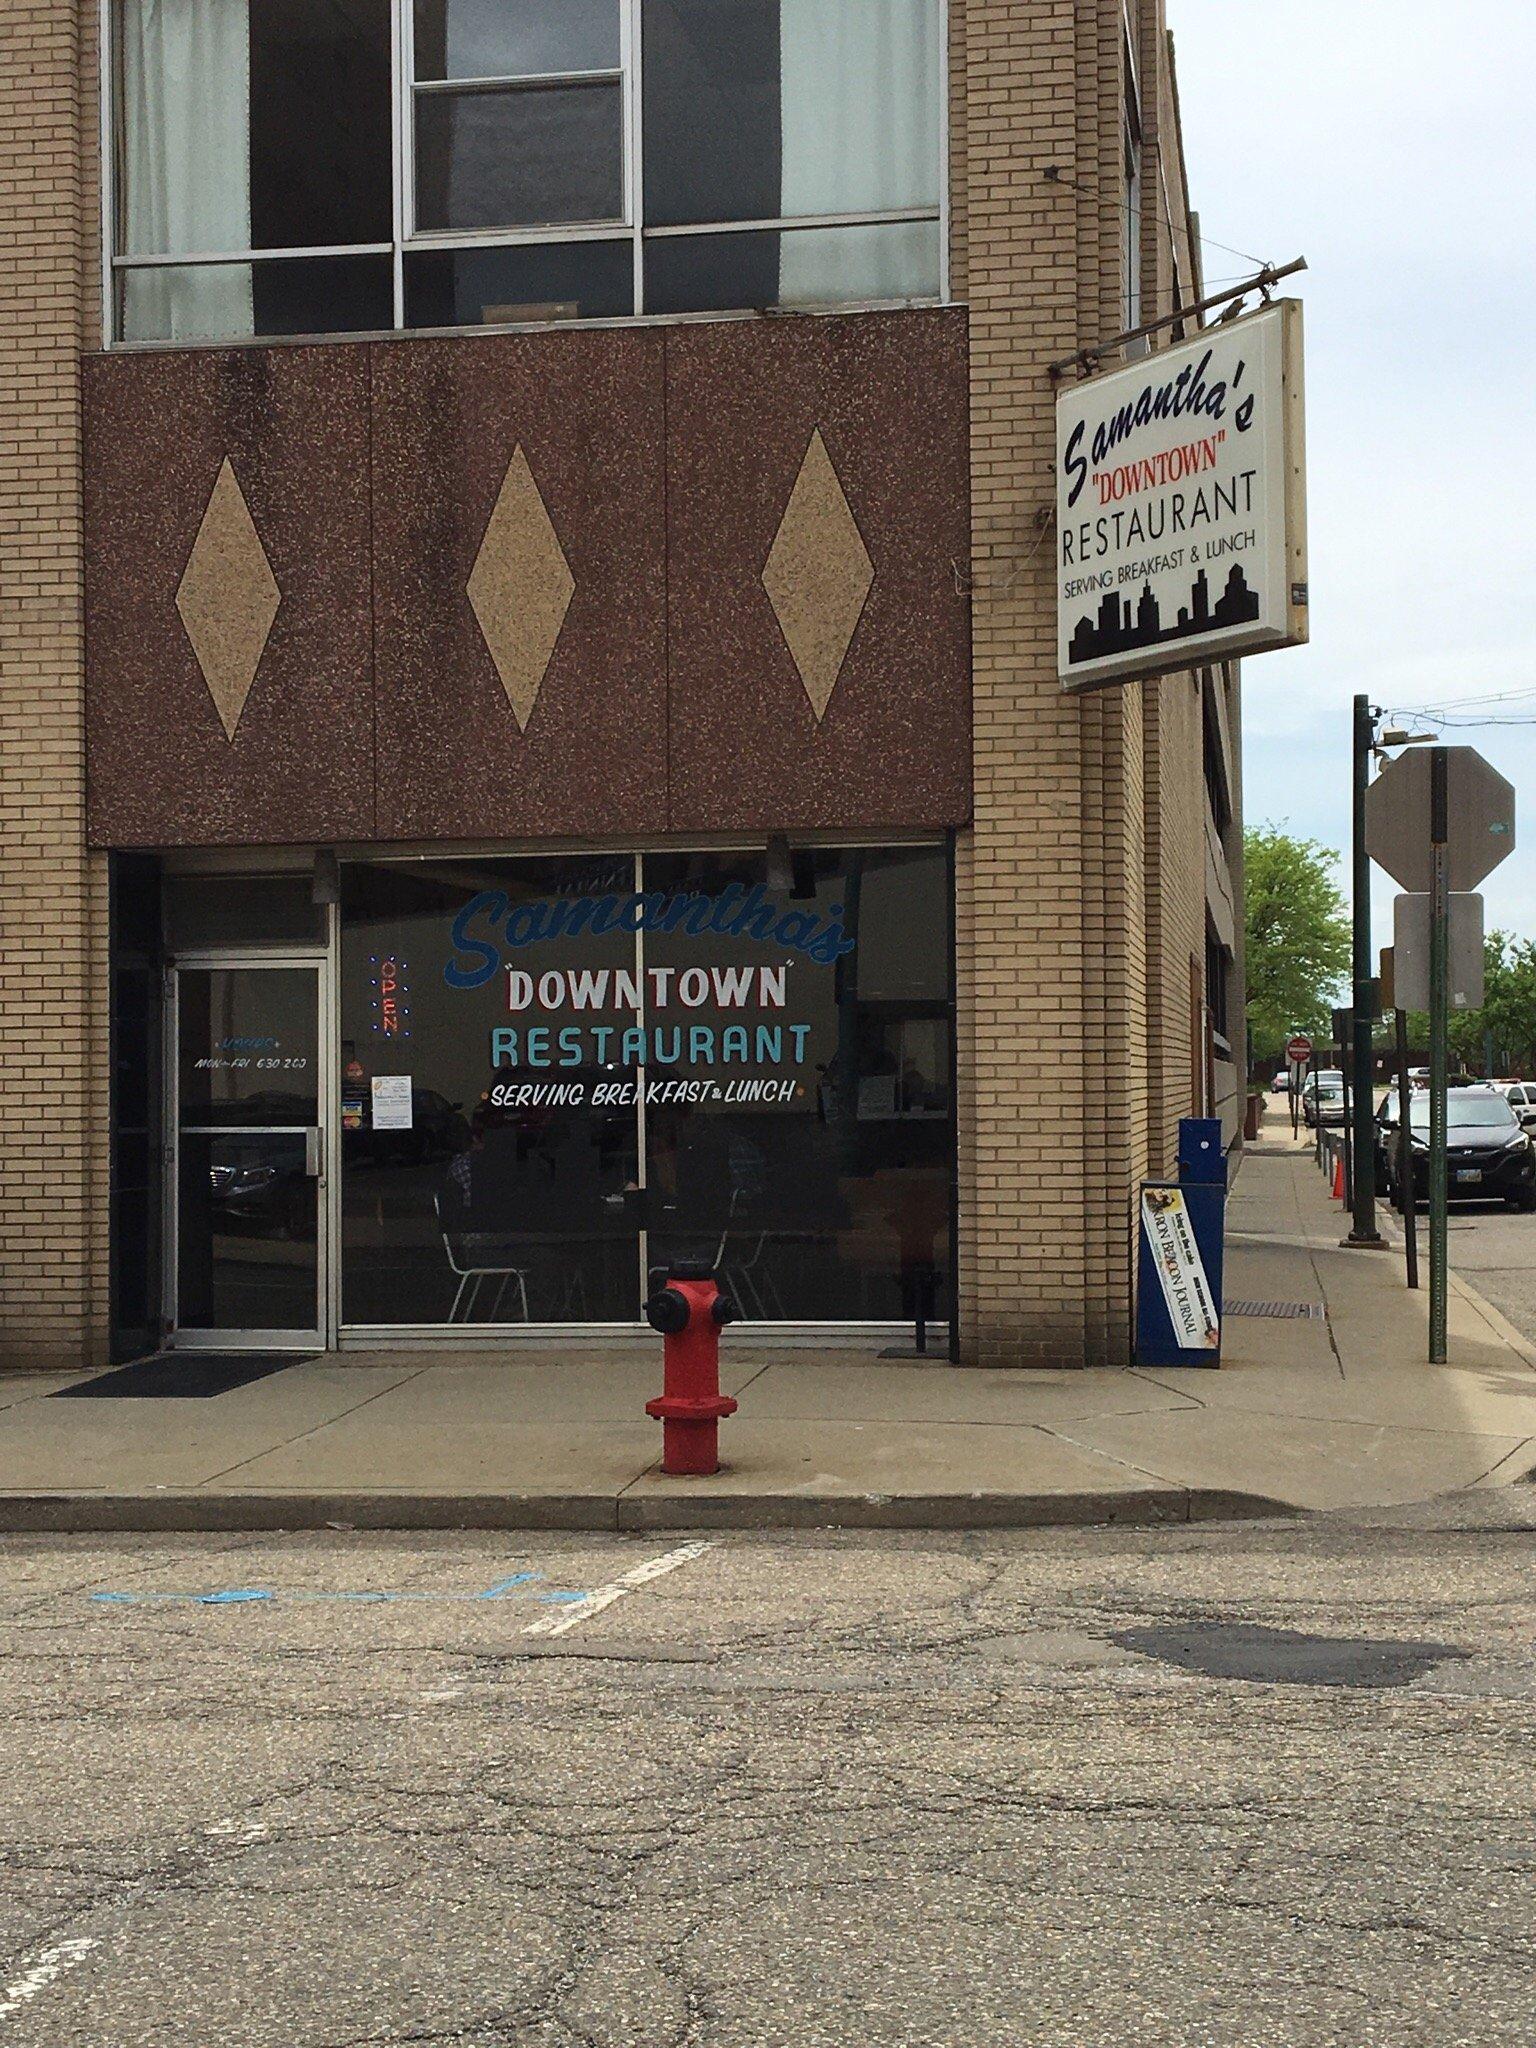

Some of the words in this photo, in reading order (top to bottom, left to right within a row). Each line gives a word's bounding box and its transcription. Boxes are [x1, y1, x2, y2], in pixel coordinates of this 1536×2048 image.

[1064, 348, 1255, 508] Samantha's
[1092, 429, 1226, 506] "DOWNTOWN"
[1062, 469, 1257, 566] RESTAURANT
[1064, 569, 1114, 599] SERVING
[1117, 548, 1185, 590] BREAKFAST
[1190, 545, 1200, 564] &
[1206, 529, 1256, 559] LUNCH
[381, 960, 398, 1033] OPEN
[504, 958, 795, 1012] "DOWNTOWN"
[490, 1024, 811, 1068] RESTAURANT
[490, 1083, 585, 1107] SERVING
[591, 1080, 711, 1107] BREAKFAST
[725, 1080, 796, 1103] LUNCH
[1161, 1241, 1183, 1285] BEACON
[1172, 1287, 1197, 1337] JOURNAL
